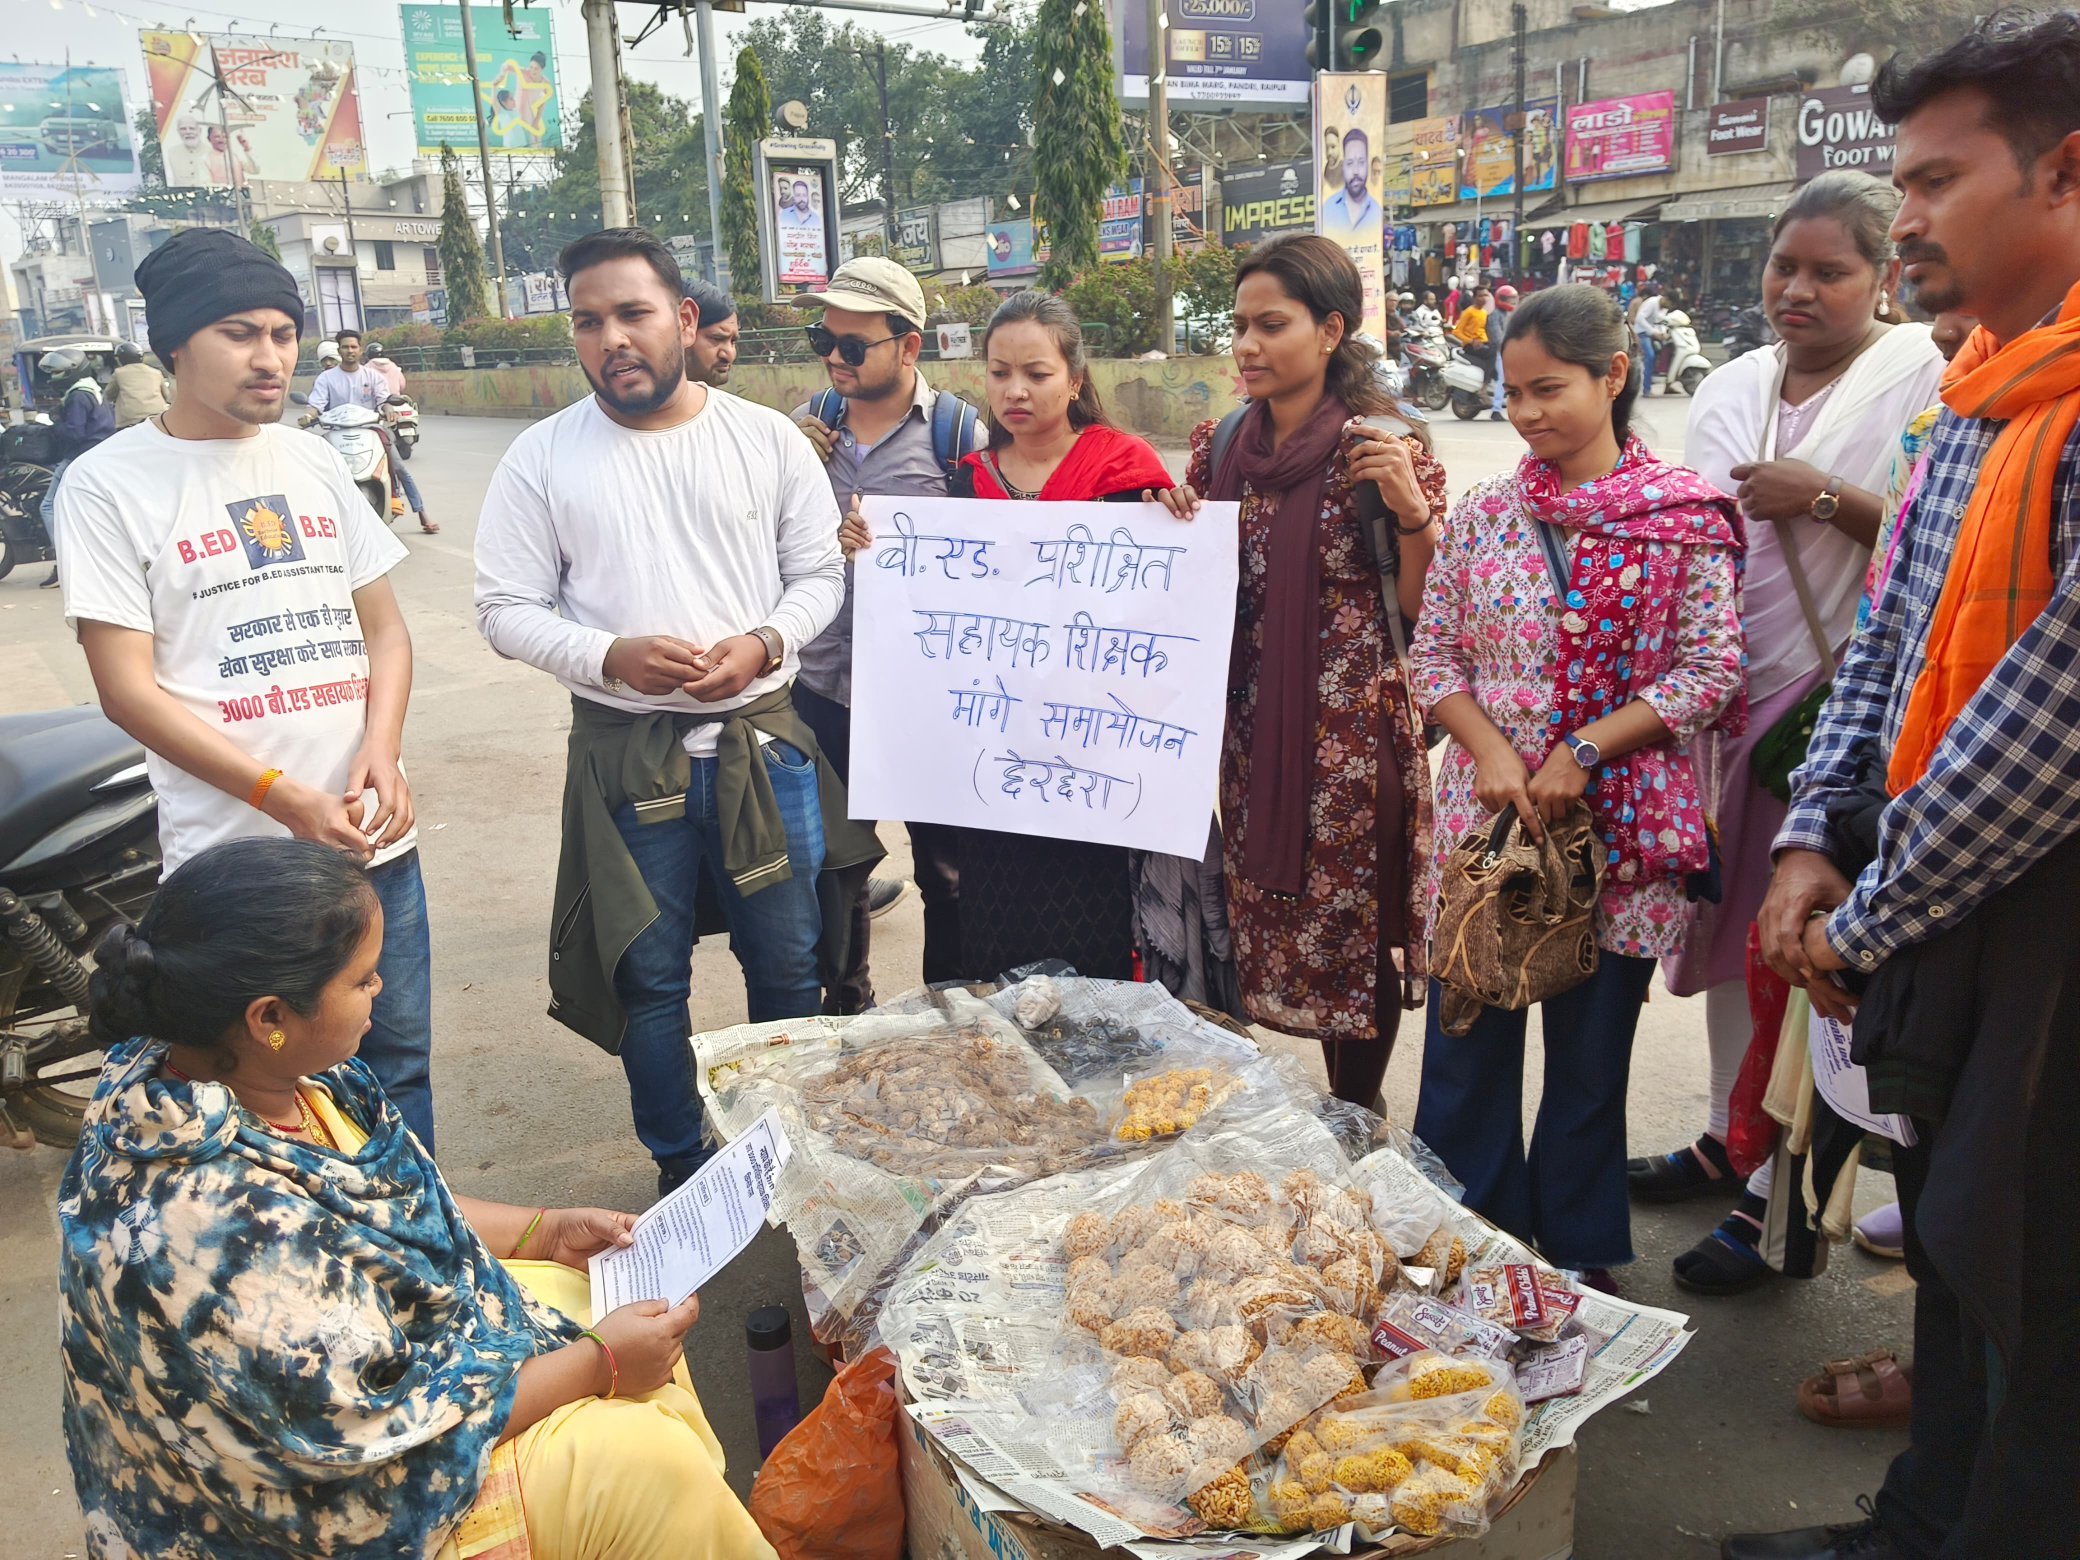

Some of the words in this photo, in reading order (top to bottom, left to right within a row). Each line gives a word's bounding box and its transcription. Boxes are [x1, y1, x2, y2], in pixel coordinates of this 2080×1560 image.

[215, 48, 300, 69] जनादेश
[1823, 145, 1873, 168] FOOT
[395, 223, 410, 233] AR
[412, 224, 442, 235] TOWE
[1225, 195, 1314, 232] IMPRESS
[177, 529, 237, 564] B.ED
[243, 575, 261, 587] FOR
[227, 614, 282, 643] सरकार
[284, 608, 296, 632] से
[296, 609, 321, 629] एक
[320, 603, 332, 626] ही
[912, 609, 1050, 668] सहायक
[1063, 611, 1201, 678] शिक्षक
[218, 655, 249, 678] सेवा
[251, 648, 295, 677] सुरक्षा
[218, 695, 264, 724] 3000
[309, 680, 354, 708] सहायक
[1040, 692, 1198, 759] समायोजन
[1375, 1329, 1409, 1357] Peanut
